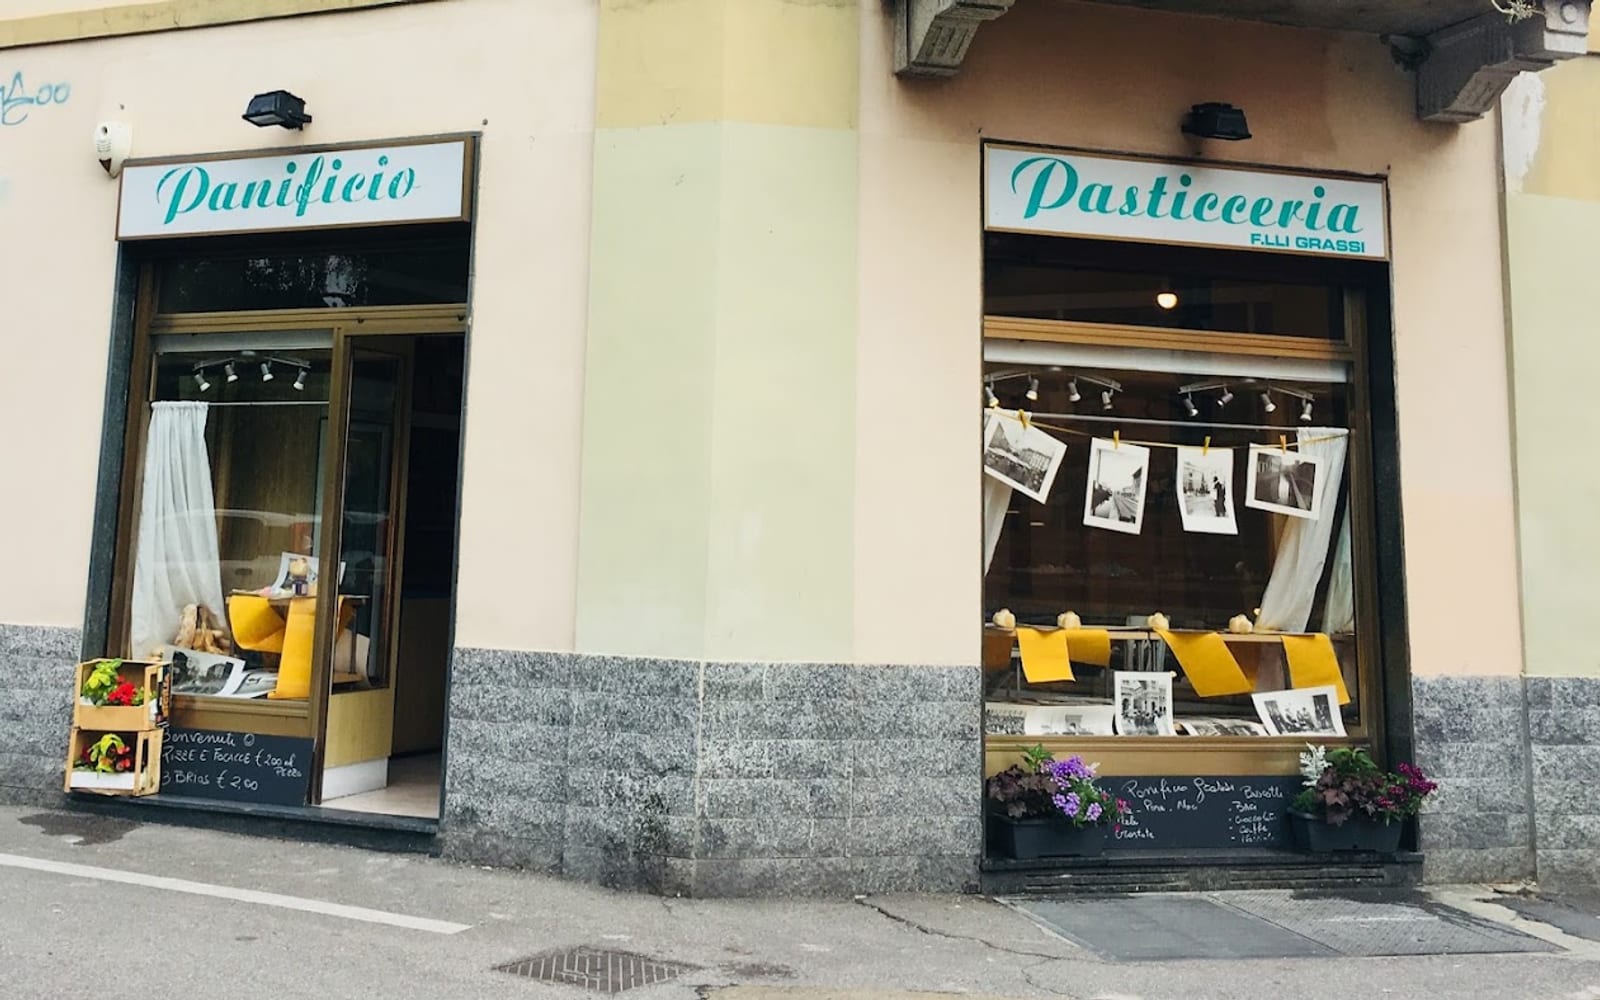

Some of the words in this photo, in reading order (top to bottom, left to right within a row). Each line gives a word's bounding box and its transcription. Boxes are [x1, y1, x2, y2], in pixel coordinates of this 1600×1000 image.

[157, 156, 421, 224] Panificio
[1011, 157, 1363, 233] Pasticceria
[1250, 233, 1290, 248] F.LLI
[1295, 236, 1365, 253] GRASSI
